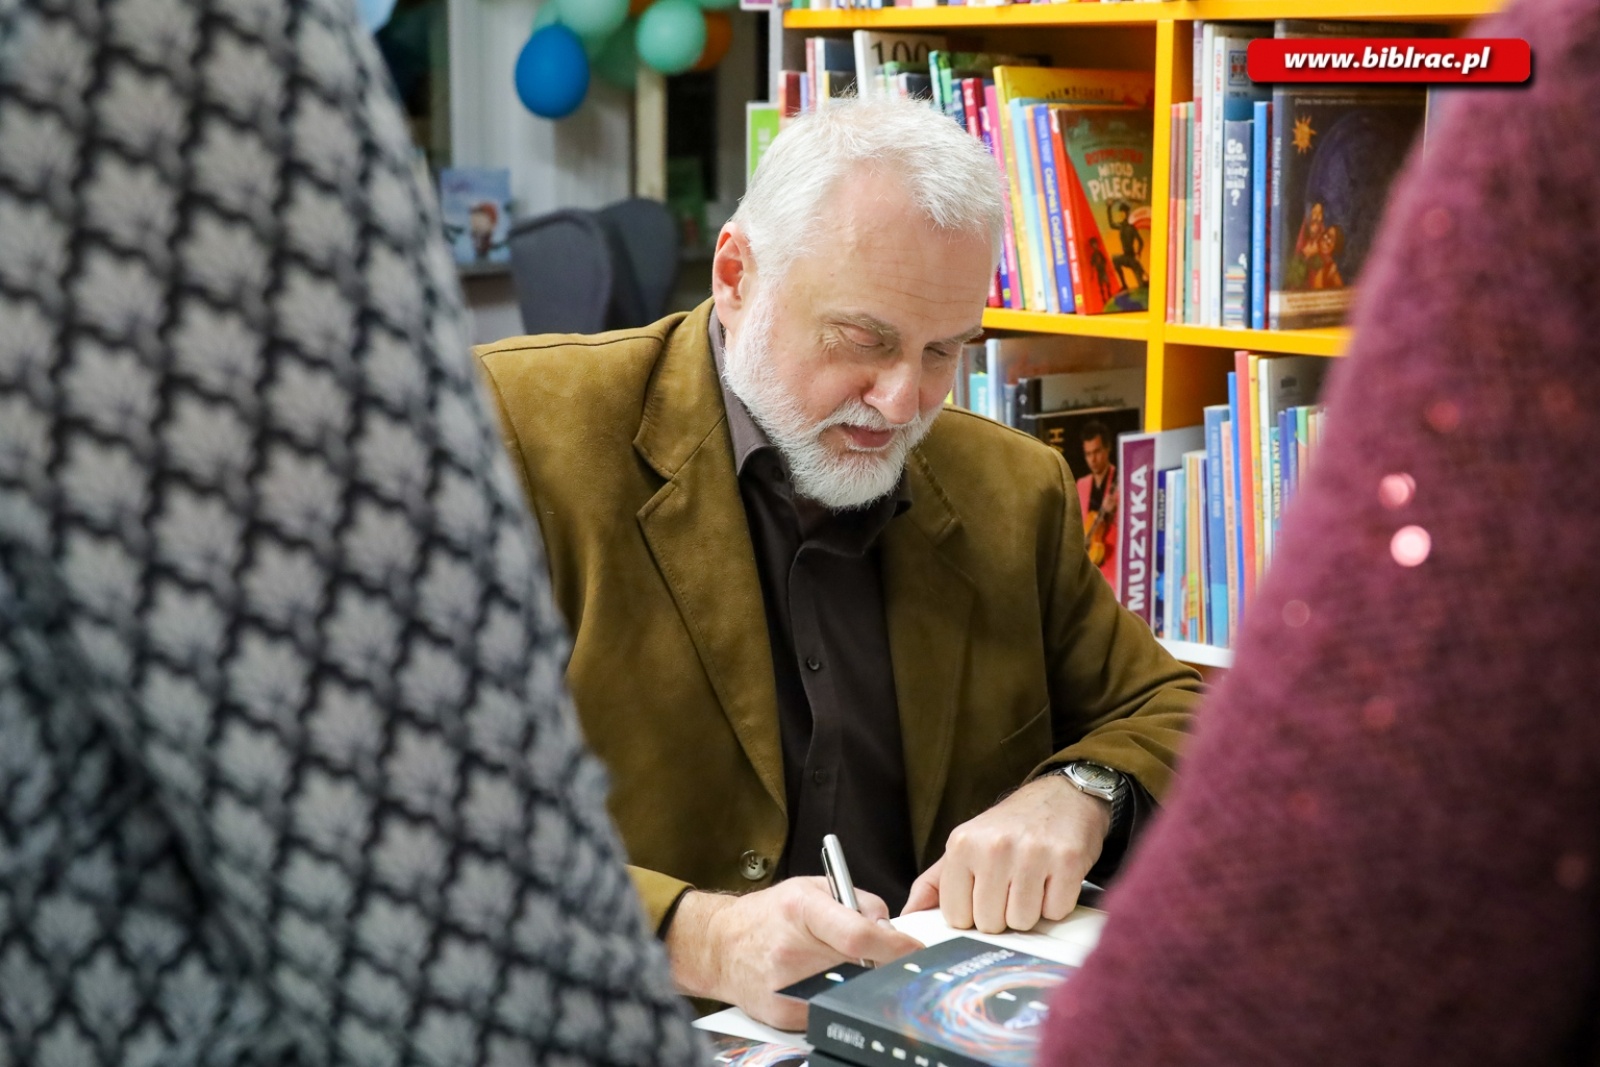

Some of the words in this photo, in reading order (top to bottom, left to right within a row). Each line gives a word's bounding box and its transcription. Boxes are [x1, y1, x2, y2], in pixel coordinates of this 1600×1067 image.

[1227, 139, 1243, 154] Co
[1127, 465, 1148, 611] MUZYKA
[826, 1023, 866, 1050] DERWISZ
